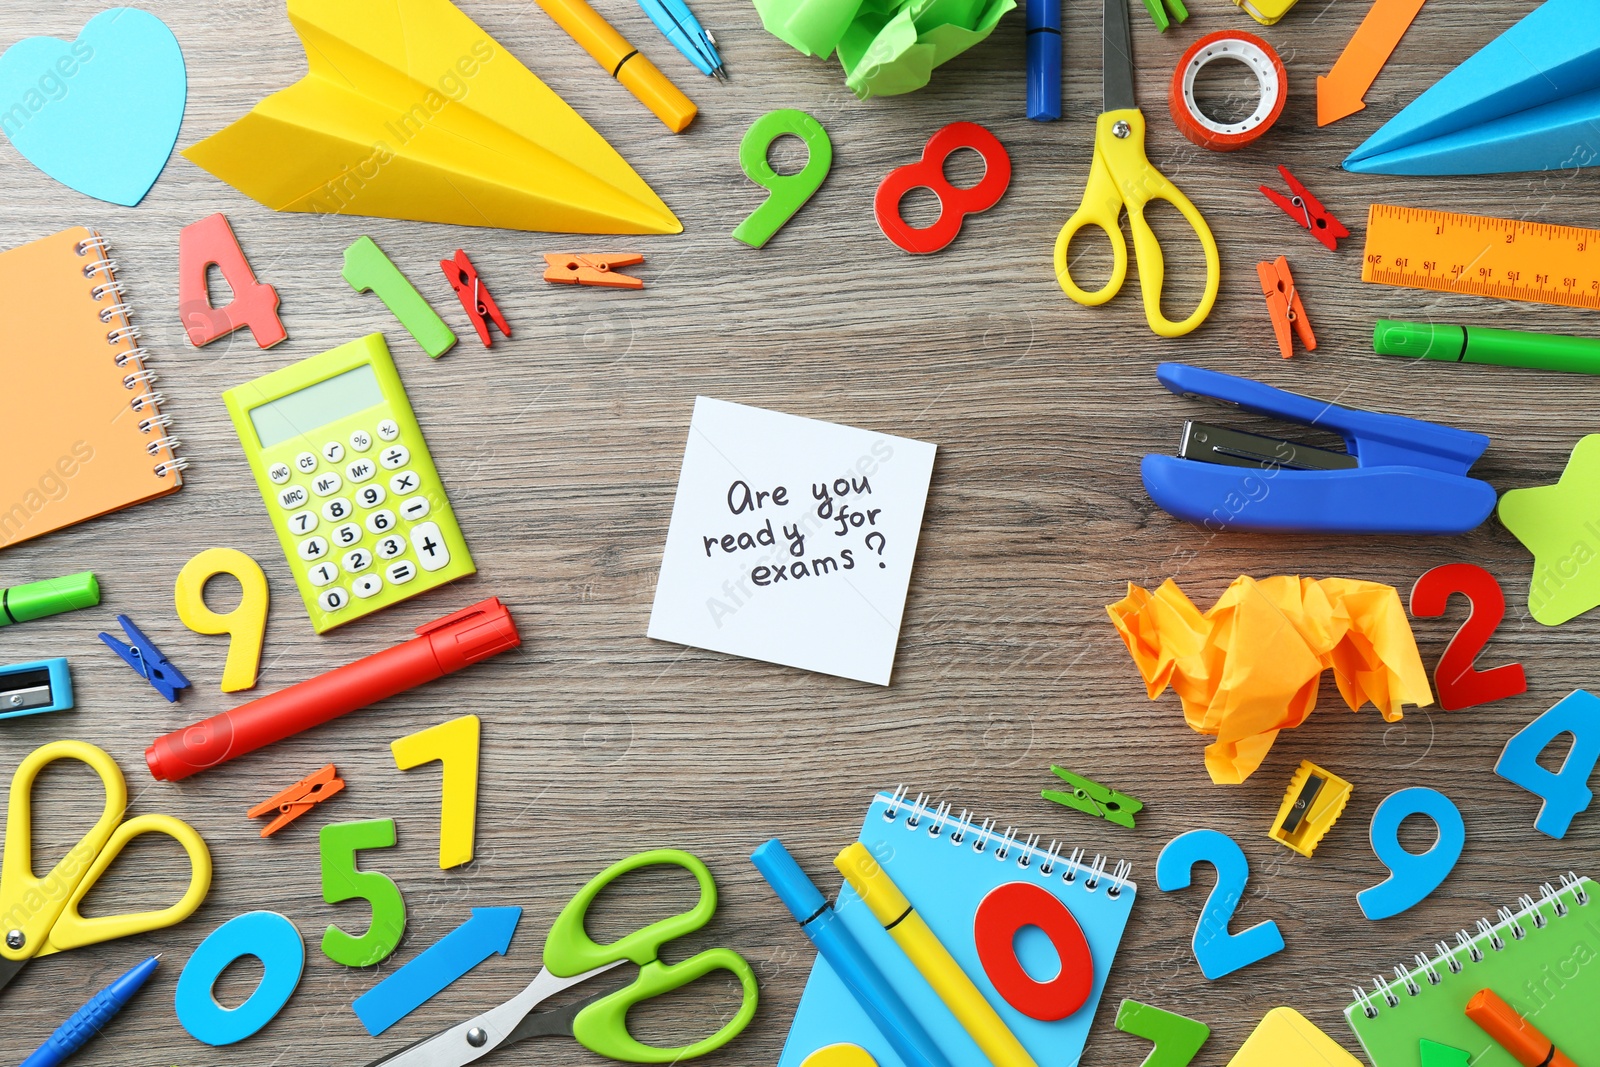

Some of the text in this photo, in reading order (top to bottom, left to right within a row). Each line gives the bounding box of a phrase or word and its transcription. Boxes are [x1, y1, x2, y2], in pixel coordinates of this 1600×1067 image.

[875, 121, 1013, 254] 8
[1505, 234, 1513, 244] 2
[1577, 243, 1584, 252] 3
[179, 213, 288, 349] 4
[299, 456, 314, 469] CE
[283, 489, 304, 505] MRC
[363, 488, 378, 504] 9
[727, 475, 872, 519] Are you
[330, 502, 344, 518] 8
[295, 514, 308, 530] 7
[374, 514, 388, 530] 6
[340, 526, 355, 543] 5
[703, 504, 882, 557] ready for
[307, 540, 320, 555] 4
[383, 539, 399, 555] 3
[350, 553, 365, 569] 2
[318, 566, 330, 581] 1
[327, 592, 341, 607] 0
[175, 548, 270, 693] 9
[1410, 562, 1528, 712] 2
[1494, 689, 1600, 841] 4
[390, 715, 481, 871] 7
[1355, 787, 1467, 922] 9
[319, 818, 407, 969] 5
[1155, 829, 1286, 982] 2
